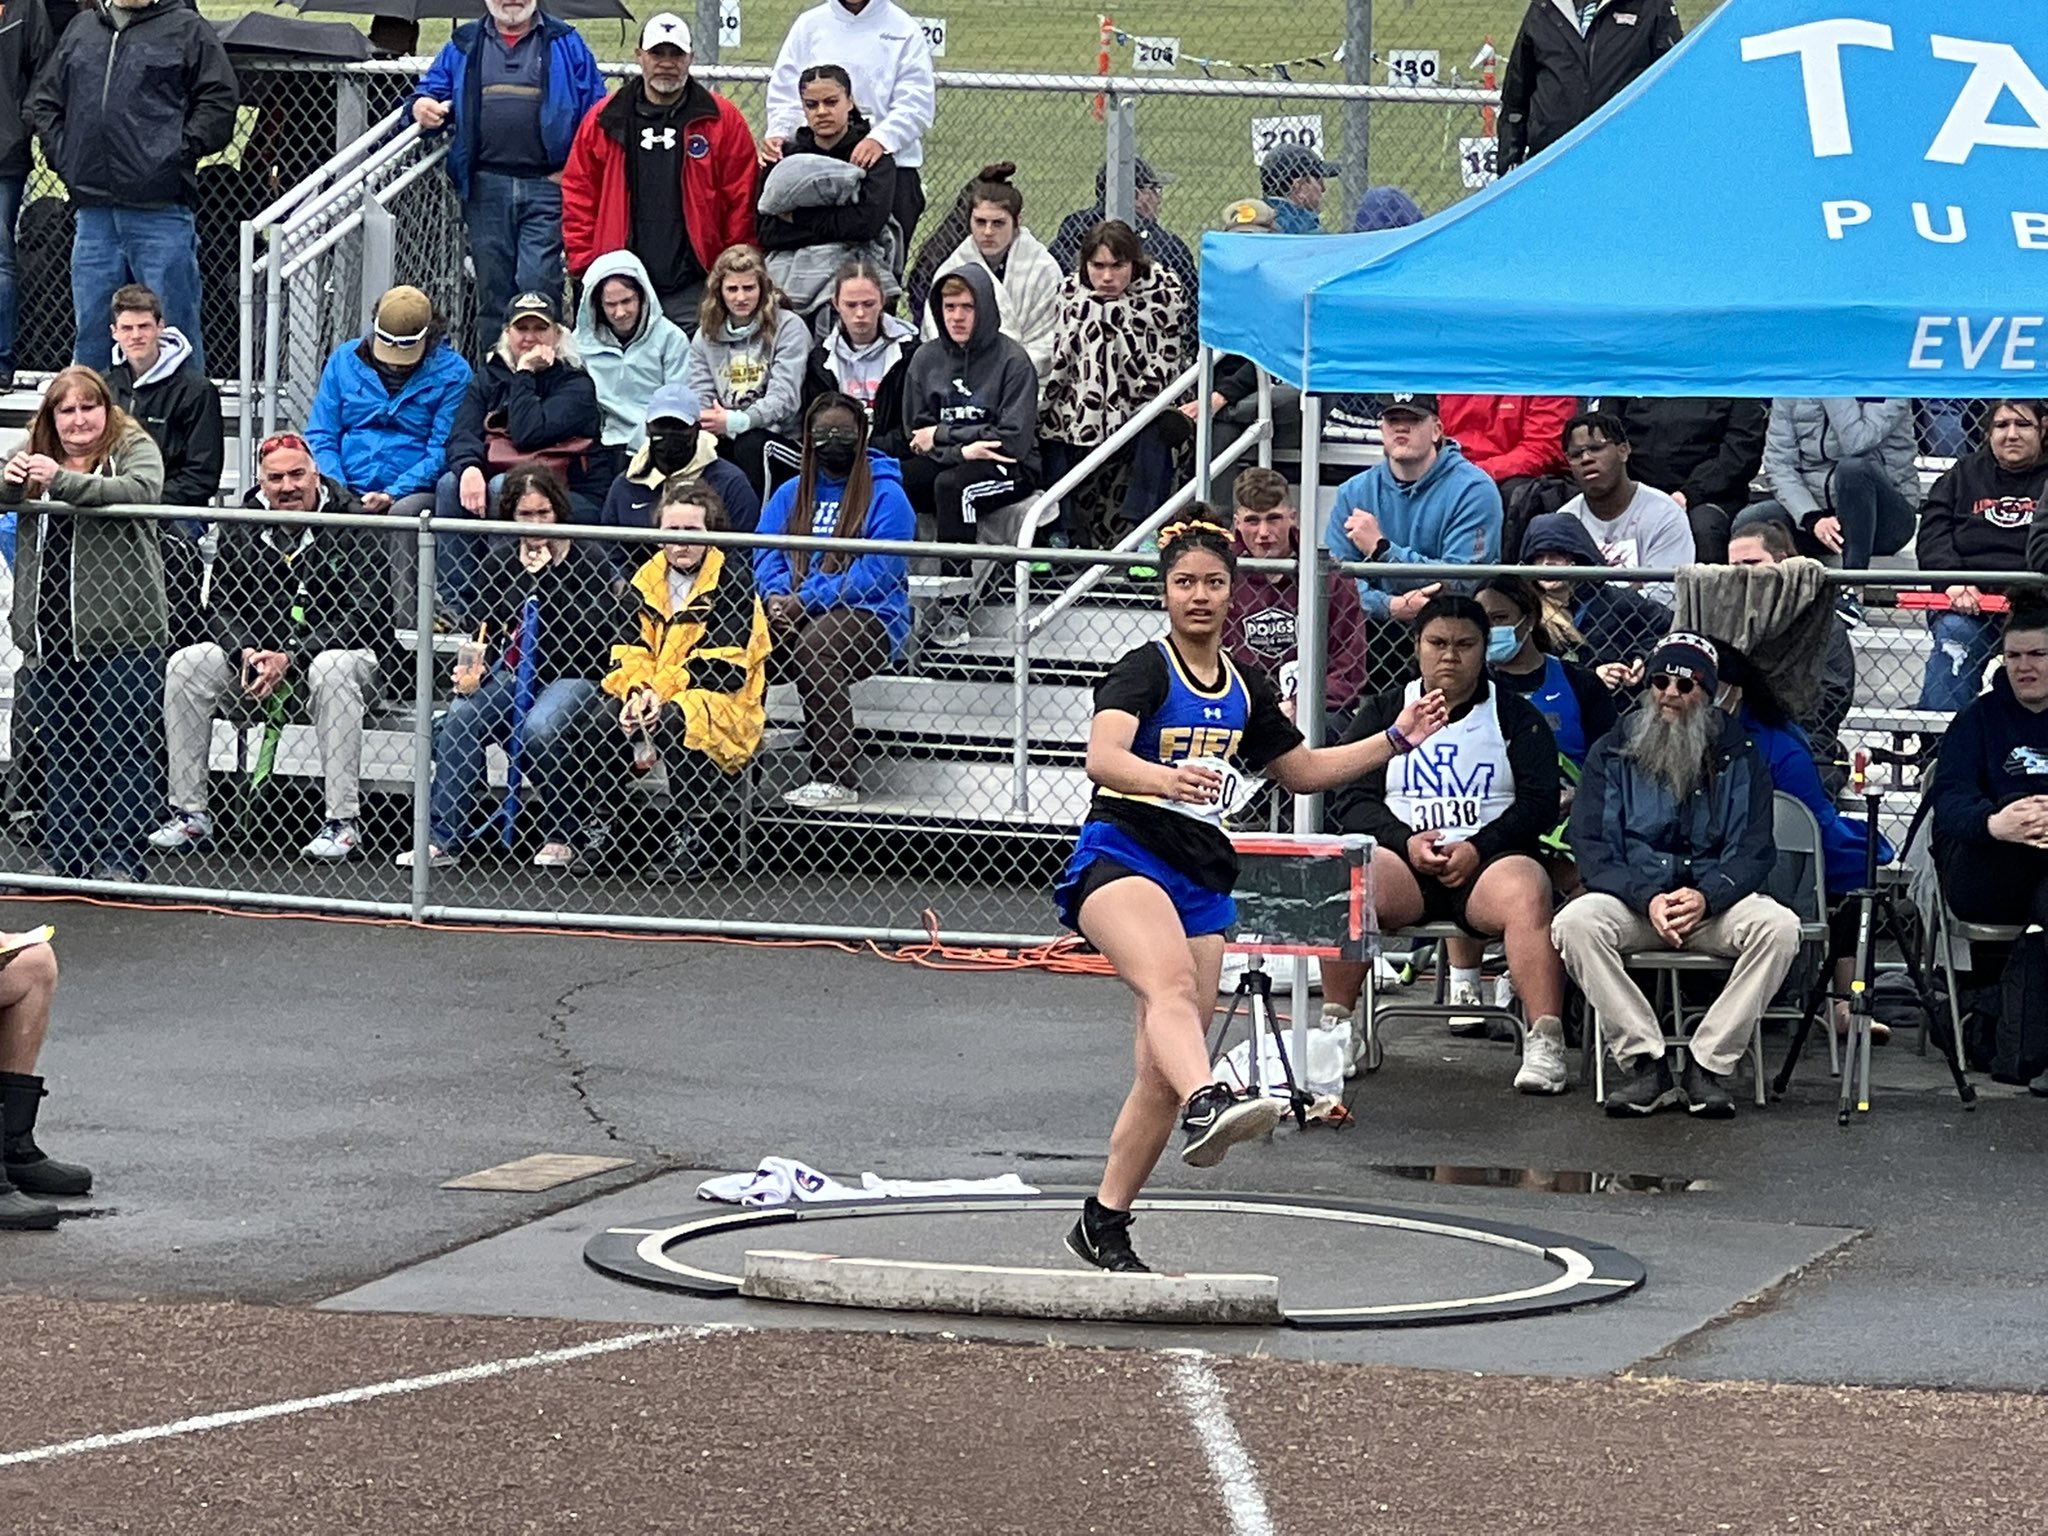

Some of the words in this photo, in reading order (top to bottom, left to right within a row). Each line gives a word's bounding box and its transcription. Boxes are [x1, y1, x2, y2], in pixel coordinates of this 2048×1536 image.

[1740, 18, 2048, 165] TA
[1822, 200, 2048, 249] PUB
[1246, 619, 1295, 638] DOUGS
